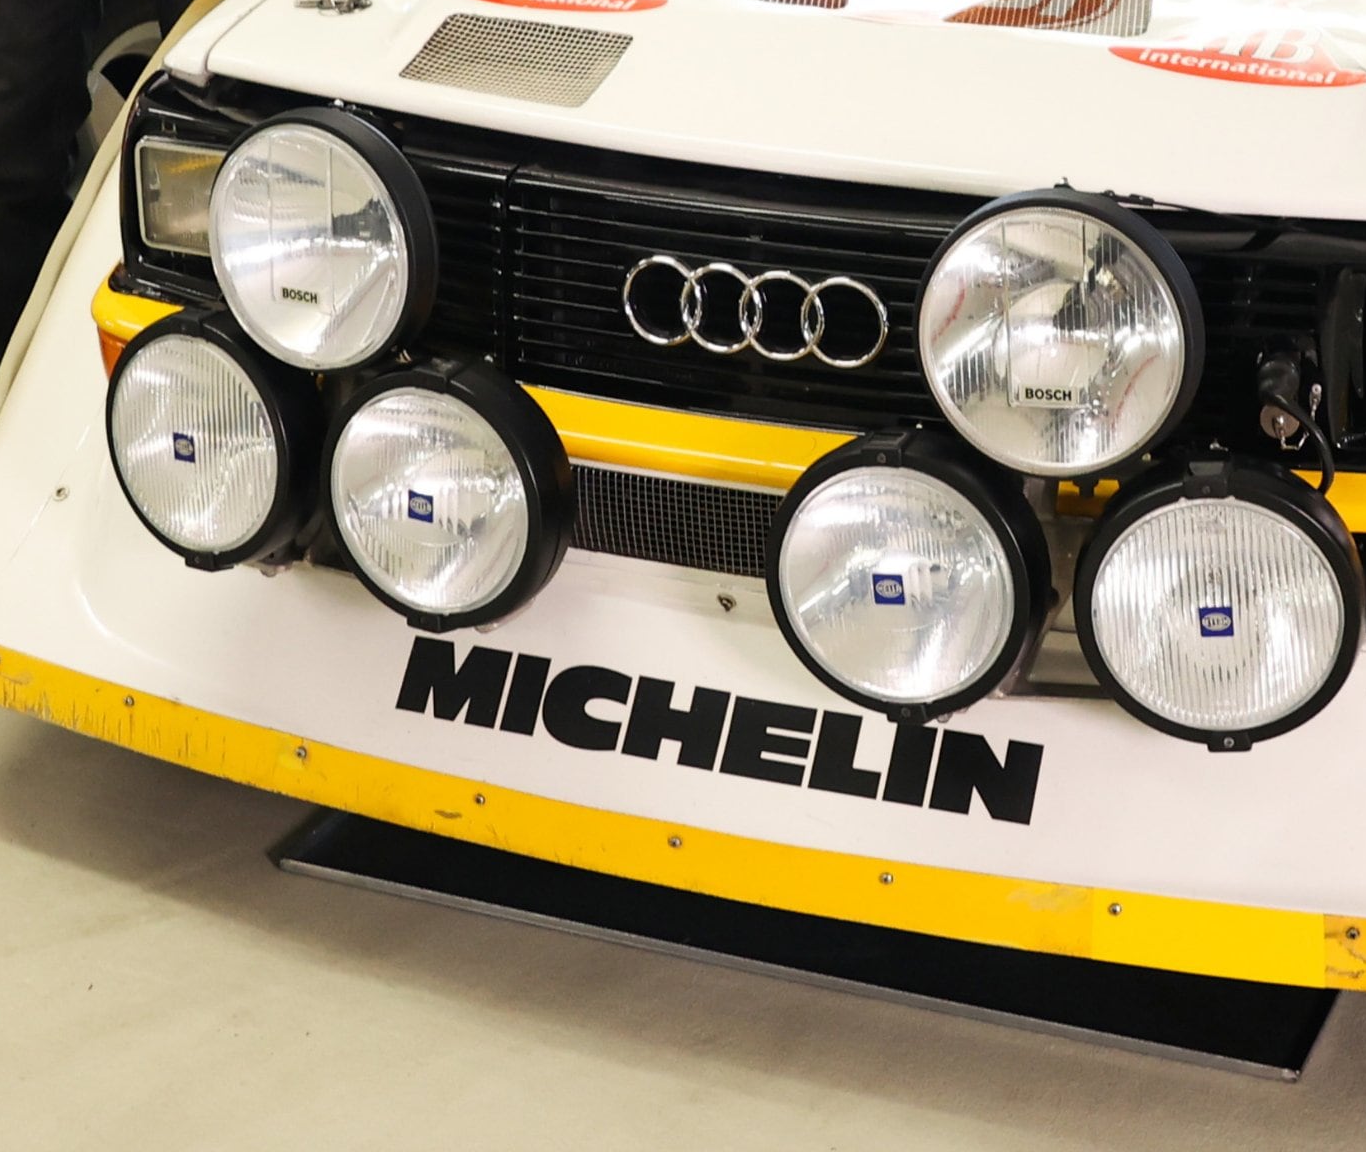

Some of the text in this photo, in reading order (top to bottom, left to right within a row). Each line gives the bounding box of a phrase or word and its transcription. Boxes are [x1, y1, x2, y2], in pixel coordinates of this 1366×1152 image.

[1138, 48, 1337, 85] international
[281, 288, 318, 304] BOSCH
[1025, 388, 1072, 402] BOSCH
[395, 635, 1046, 826] MICHELIN
